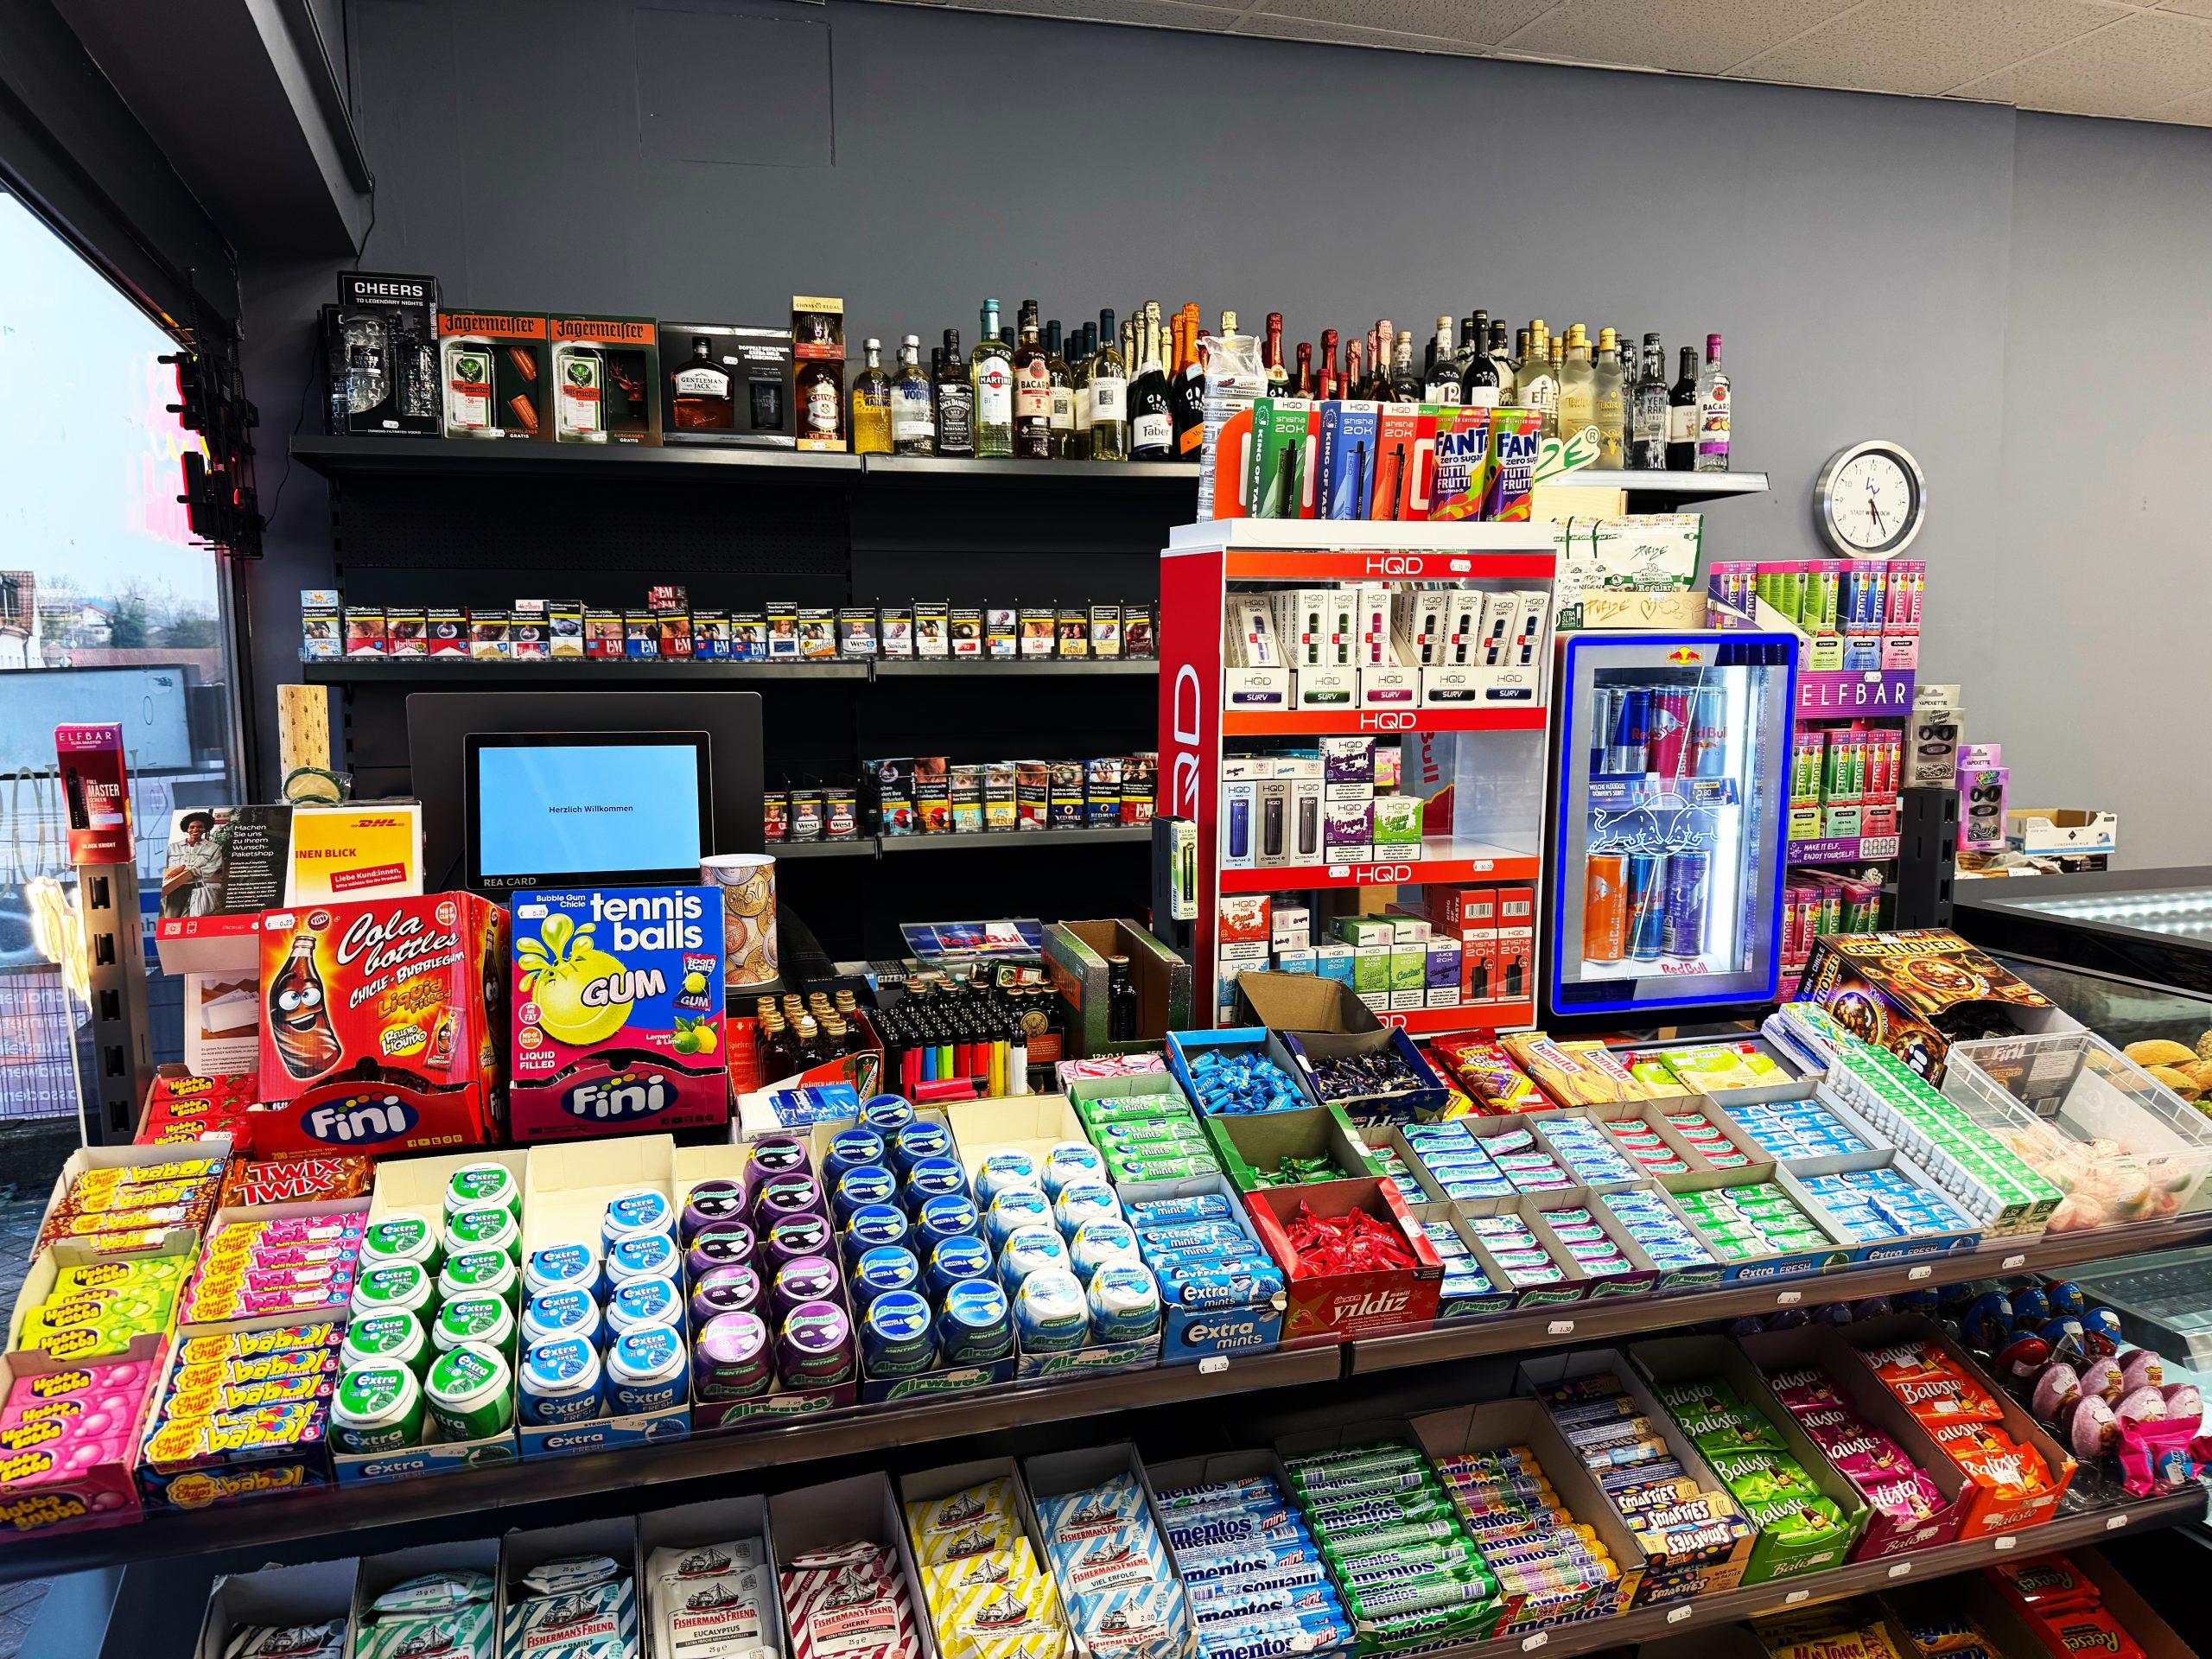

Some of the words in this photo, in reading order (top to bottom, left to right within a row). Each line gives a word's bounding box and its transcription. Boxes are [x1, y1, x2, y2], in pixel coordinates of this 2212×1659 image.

[355, 283, 423, 297] CHEERS
[445, 315, 534, 334] Jägermeister
[557, 320, 644, 340] Jägermeister
[1512, 385, 1529, 403] 12
[1143, 425, 1169, 436] Faber
[1275, 424, 1305, 433] 20K
[1344, 426, 1372, 435] 20K
[1384, 429, 1413, 437] 20K
[1529, 454, 1552, 463] sugar
[1254, 462, 1262, 481] OF
[1507, 466, 1535, 478] TUTTI
[1573, 467, 1600, 479] TUTTI
[1506, 476, 1540, 489] FRUTTI
[1572, 478, 1602, 489] FRUTTI
[1366, 556, 1423, 575] HQD
[1246, 693, 1268, 702] SURV
[1442, 690, 1462, 699] SURV
[1802, 683, 1906, 706] ELFBAR
[1360, 712, 1416, 730] HQD
[88, 785, 119, 798] MASTER
[296, 850, 321, 859] INEN
[325, 849, 356, 857] BLICK
[1823, 849, 1854, 859] YOURSELF!
[357, 868, 401, 879] Kund:innen,
[506, 877, 537, 886] CARD
[1357, 865, 1411, 882] HQD
[536, 894, 563, 903] Bubble
[565, 893, 586, 903] Gum
[589, 893, 702, 921] tennis
[1451, 911, 1455, 921] OF
[613, 921, 704, 950] balls
[1609, 917, 1620, 939] Bull
[337, 909, 424, 966] Cola
[941, 936, 980, 947] Red
[984, 934, 1021, 945] Bull
[364, 932, 459, 976] bottles
[1465, 948, 1495, 957] 20K
[1609, 940, 1618, 959] Red
[1843, 941, 1962, 955] DESTROYER
[348, 976, 389, 1009] CHICLE
[395, 950, 465, 984] BUBBLEGUM
[878, 974, 906, 983] GIZEH
[1396, 969, 1420, 980] Cactus
[582, 969, 666, 1007] GUM
[377, 978, 443, 1019] Liquid
[410, 988, 452, 1014] Filled
[680, 996, 709, 1007] GUM
[519, 1052, 555, 1061] LIQUID
[519, 1060, 555, 1069] FILLED
[1535, 1043, 1578, 1073] hanuta
[1588, 1052, 1629, 1081] hanuta
[573, 1074, 667, 1117] Fini
[312, 1096, 406, 1135] Fini
[1122, 1102, 1149, 1112] mints
[1508, 1131, 1566, 1143] Airwaves
[248, 1157, 343, 1179] TWIX
[1528, 1159, 1588, 1173] Airwaves
[234, 1175, 334, 1205] TWIX
[1868, 1248, 1903, 1260] extra
[76, 1263, 118, 1281] Hubba
[86, 1268, 129, 1285] Bubba
[1738, 1267, 1774, 1279] extra
[1779, 1263, 1811, 1273] FRESH
[1185, 1283, 1230, 1300] extra
[1694, 1287, 1758, 1305] Airwaves
[1205, 1296, 1236, 1307] mints
[1330, 1290, 1409, 1325] yıldız
[1622, 1294, 1688, 1313] Airwaves
[1187, 1319, 1255, 1346] extra
[1216, 1333, 1262, 1350] mints
[190, 1334, 229, 1354] Chupa
[190, 1344, 231, 1363] Chups
[34, 1370, 81, 1390] Hubba
[42, 1376, 90, 1396] Bubba
[1897, 1378, 1963, 1406] Balisto
[1680, 1411, 1743, 1436] Balisto
[1715, 1455, 1773, 1482] Balisto
[1618, 1484, 1676, 1509] SMARTIES
[1261, 1510, 1290, 1529] mint
[1323, 1504, 1403, 1529] mentos
[1648, 1500, 1710, 1531] SMARTIES
[1986, 1509, 2037, 1532] Balisto
[1169, 1517, 1253, 1544] mentos
[1668, 1526, 1729, 1554] SMARTIES
[1276, 1549, 1306, 1567] mint
[1090, 1578, 1108, 1588] VIEL
[1109, 1570, 1137, 1584] ERFOLG!
[1242, 1573, 1317, 1594] mentos
[1360, 1588, 1418, 1608] mentos
[813, 1611, 864, 1630] FISHERMAN'S
[841, 1618, 870, 1630] CHERRY
[527, 1625, 582, 1649] FISHERMAN'S
[693, 1626, 741, 1639] EUCALYPTUS
